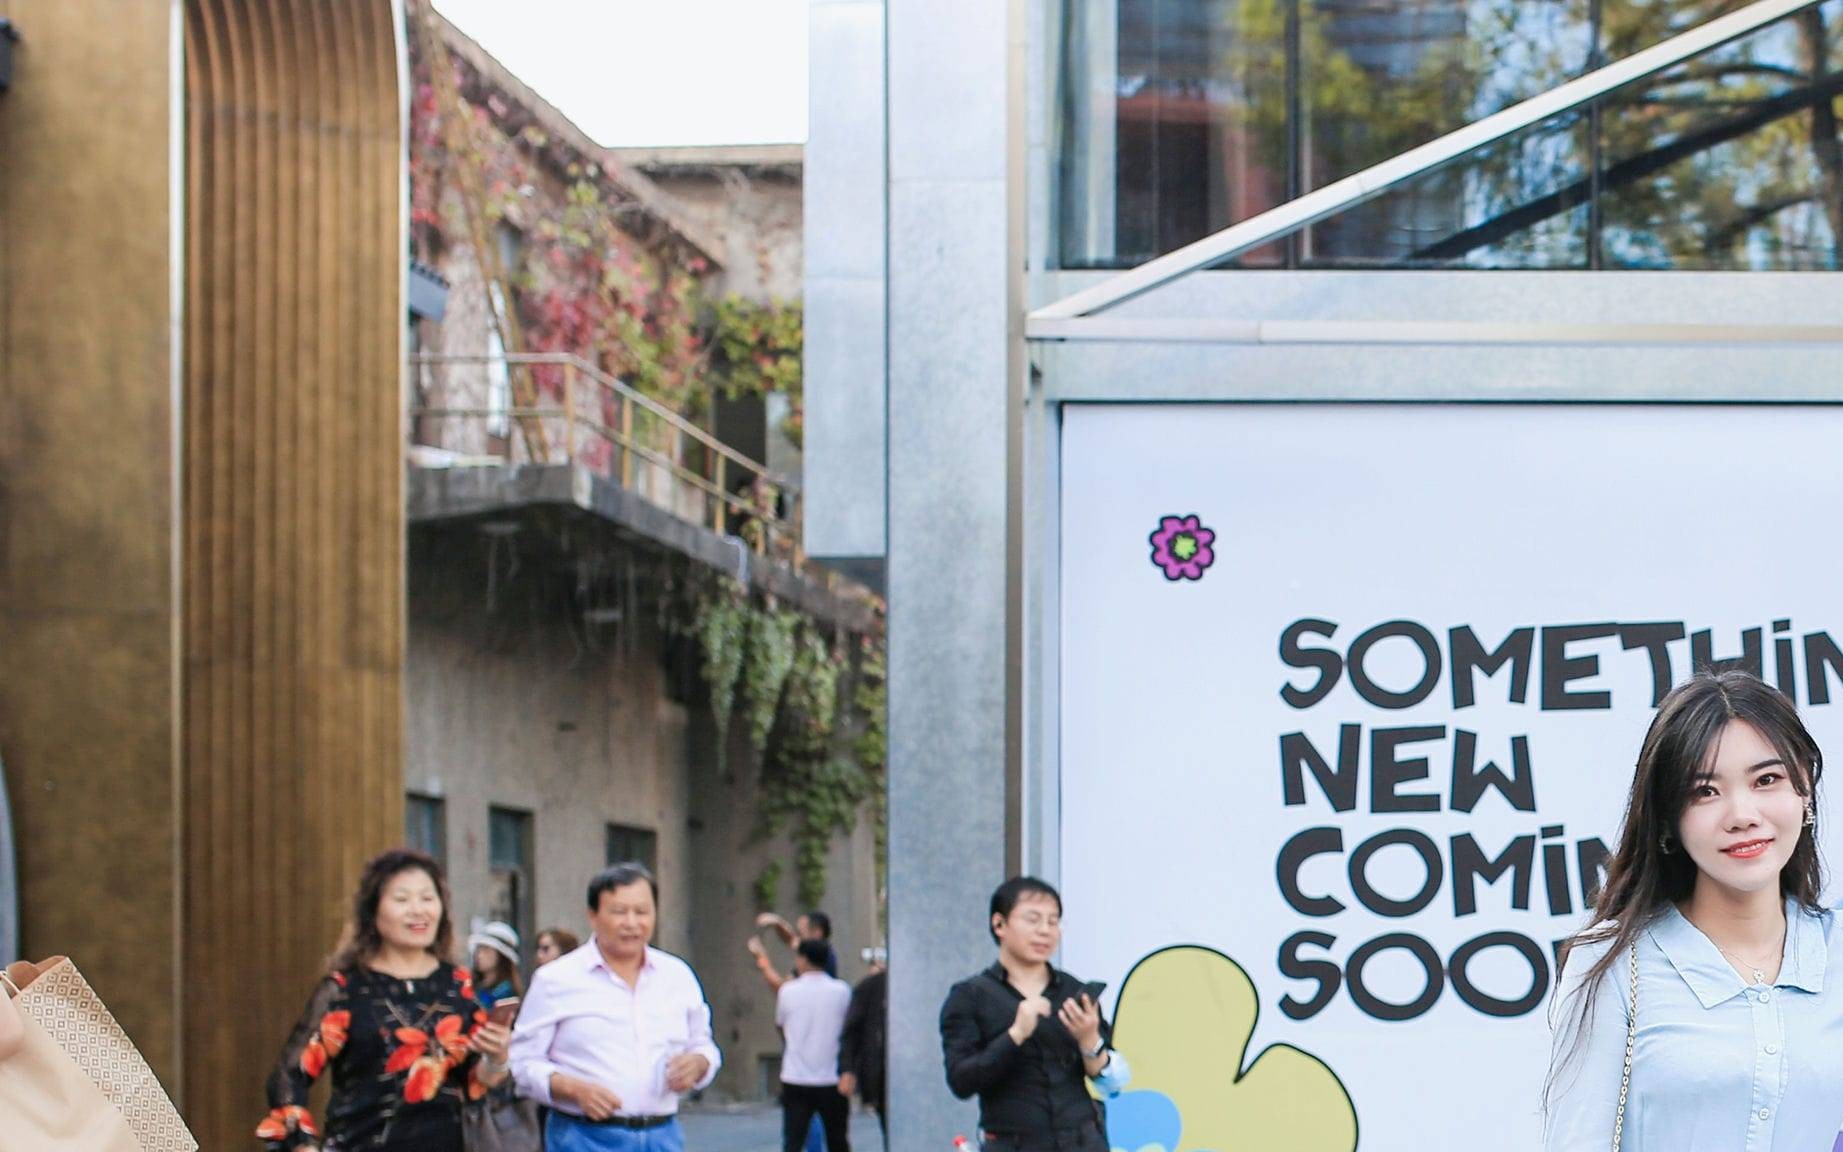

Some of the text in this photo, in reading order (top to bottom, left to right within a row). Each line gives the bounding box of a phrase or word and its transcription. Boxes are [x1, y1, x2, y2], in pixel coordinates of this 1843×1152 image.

[1279, 723, 1537, 814] NEW
[1276, 824, 1614, 918] COMi
[1278, 930, 1566, 1021] SOO
